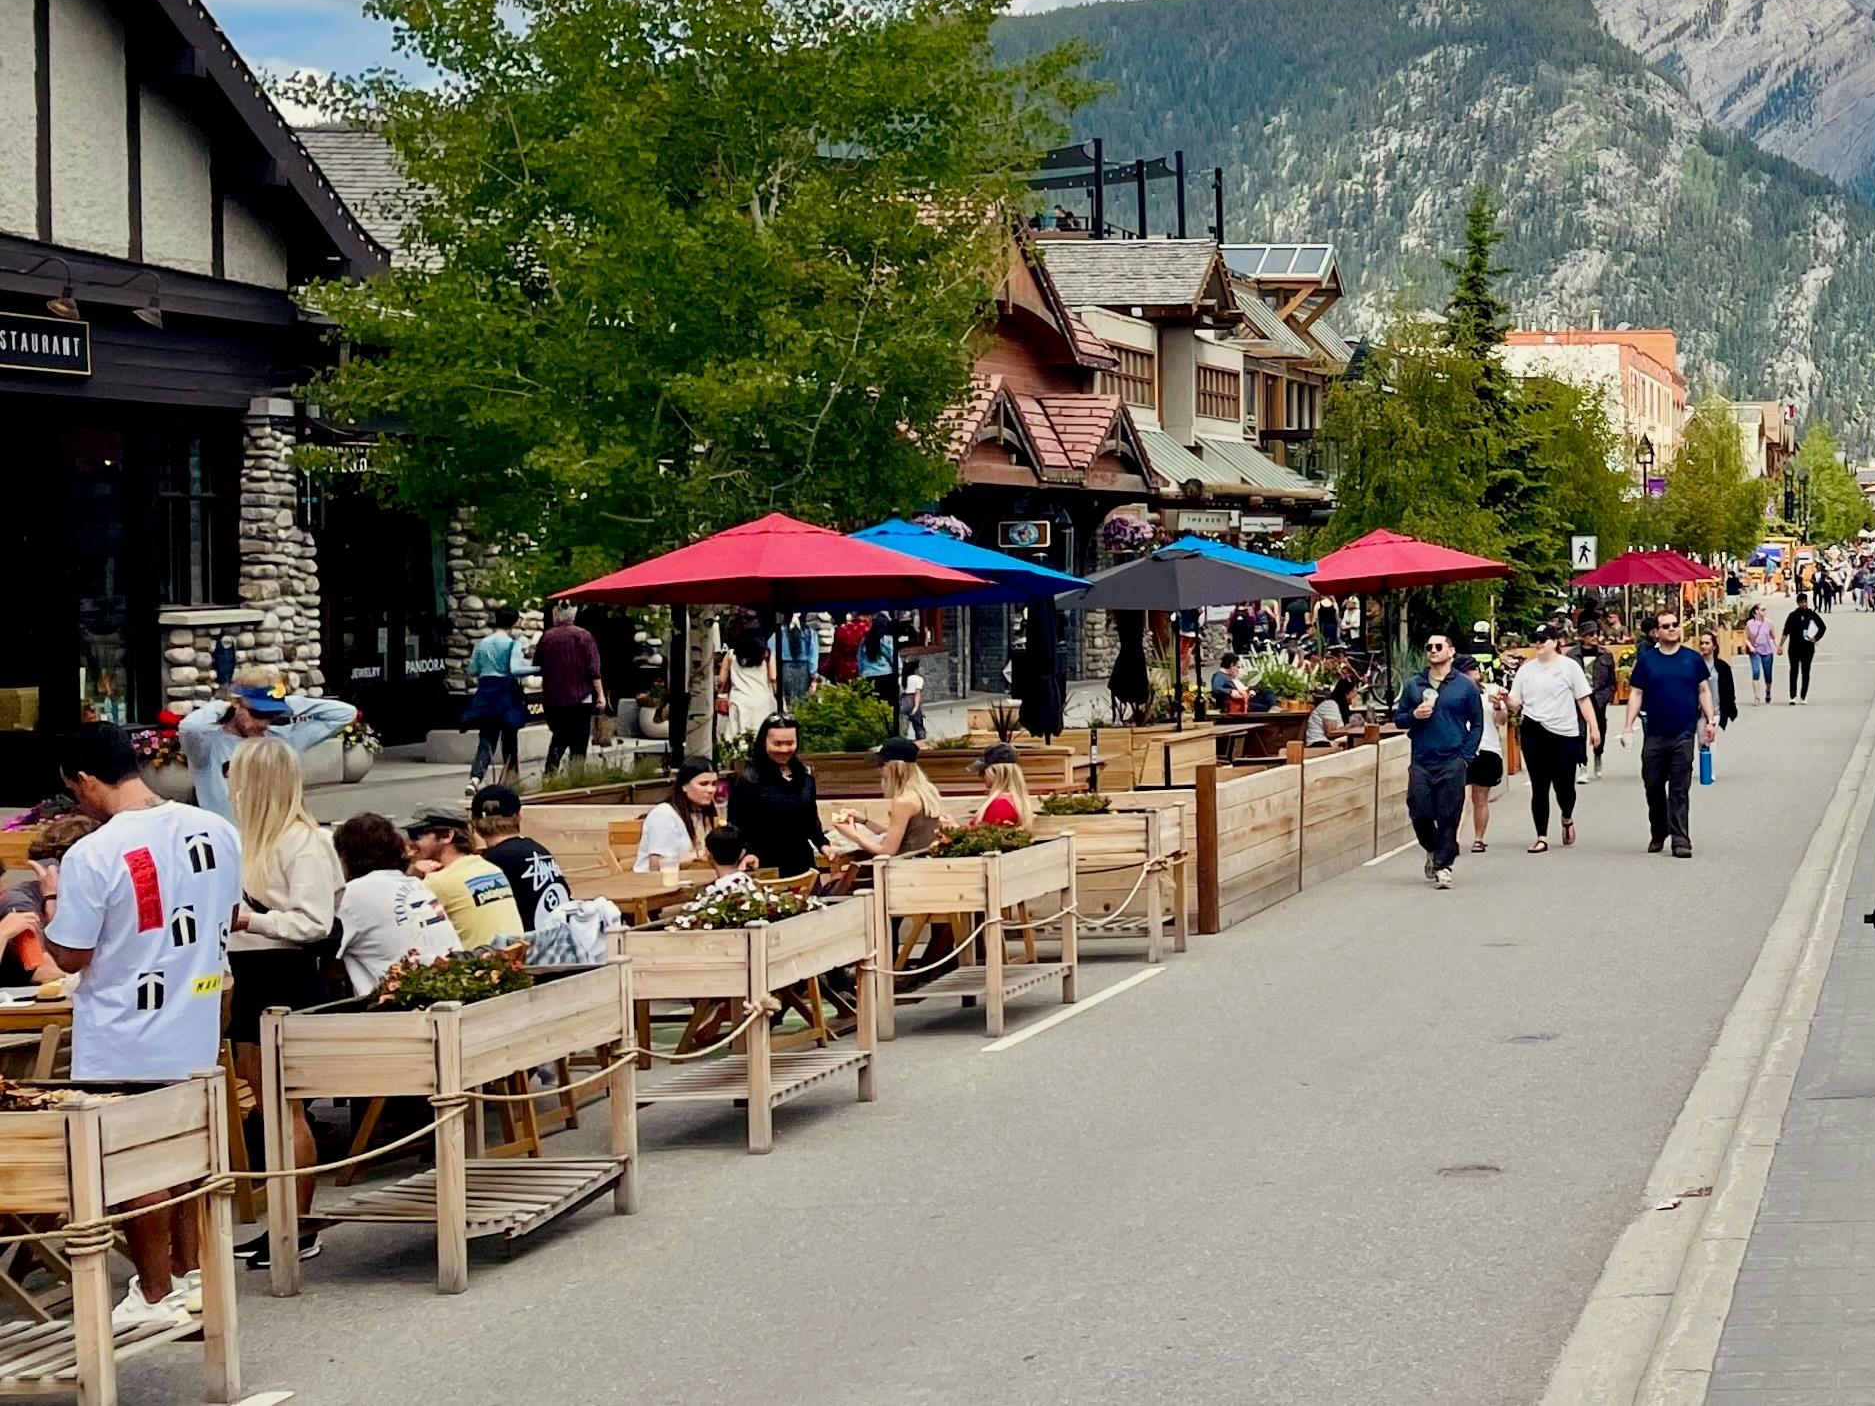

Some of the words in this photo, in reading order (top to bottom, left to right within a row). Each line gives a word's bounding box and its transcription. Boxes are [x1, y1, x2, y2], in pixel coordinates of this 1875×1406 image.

[0, 329, 80, 357] STAURANT
[351, 666, 381, 680] JEWELRY
[405, 656, 446, 675] PANDORA
